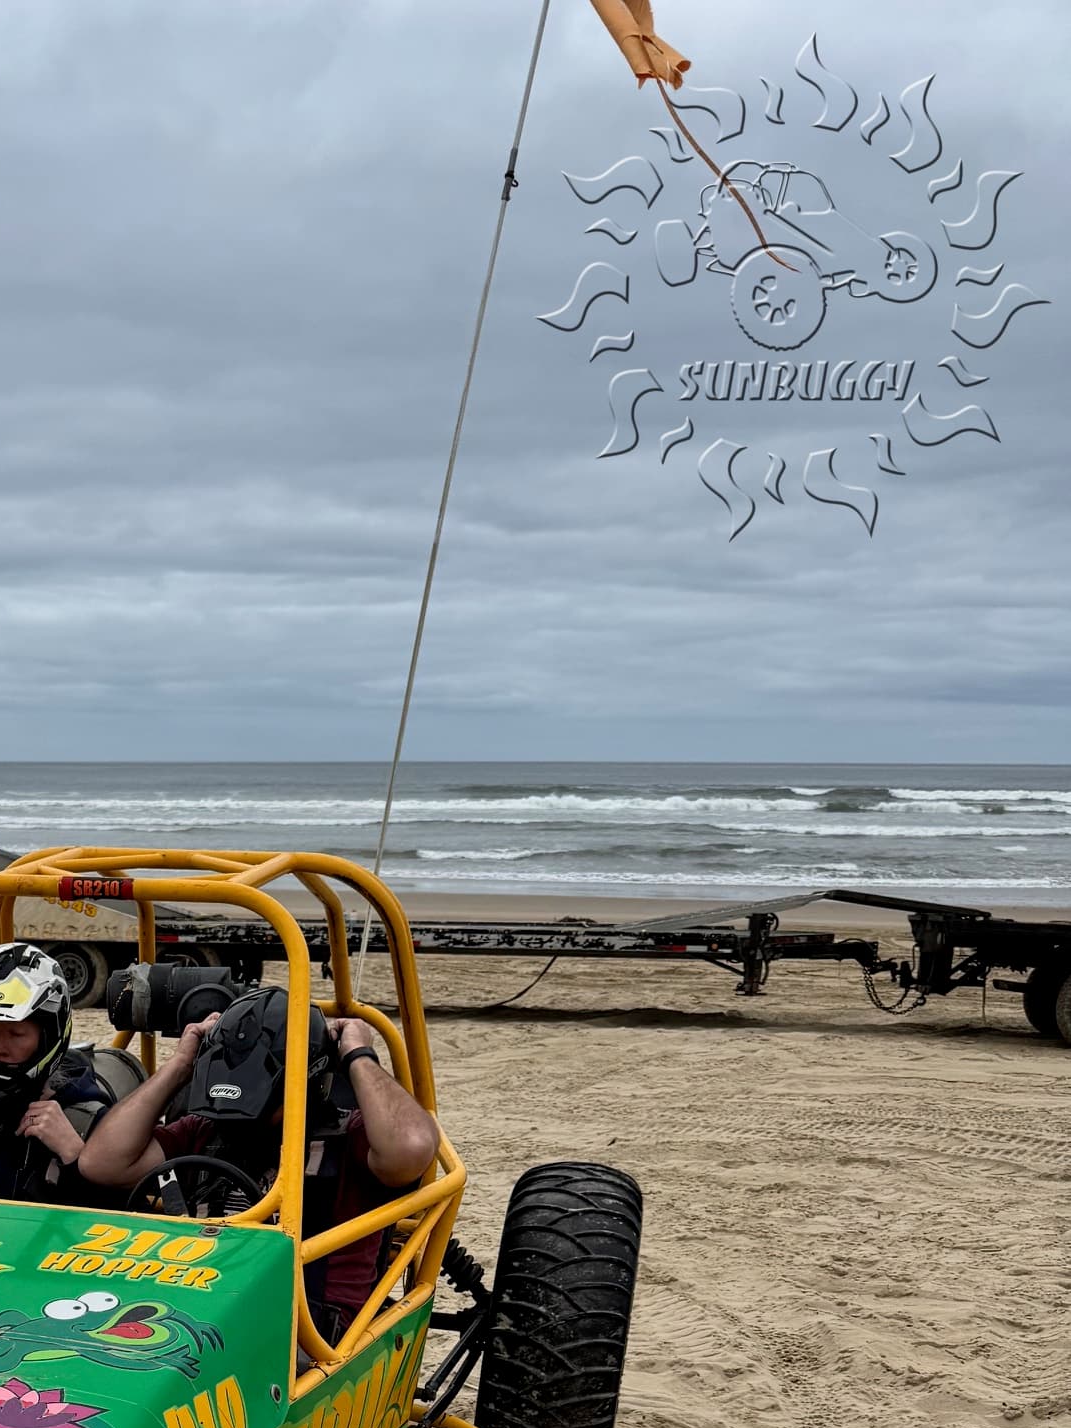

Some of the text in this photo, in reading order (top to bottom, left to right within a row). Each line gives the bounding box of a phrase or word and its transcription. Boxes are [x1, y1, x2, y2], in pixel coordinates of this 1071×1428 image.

[73, 879, 120, 897] SB210
[72, 1223, 217, 1263] 210
[40, 1252, 220, 1291] HOPPER
